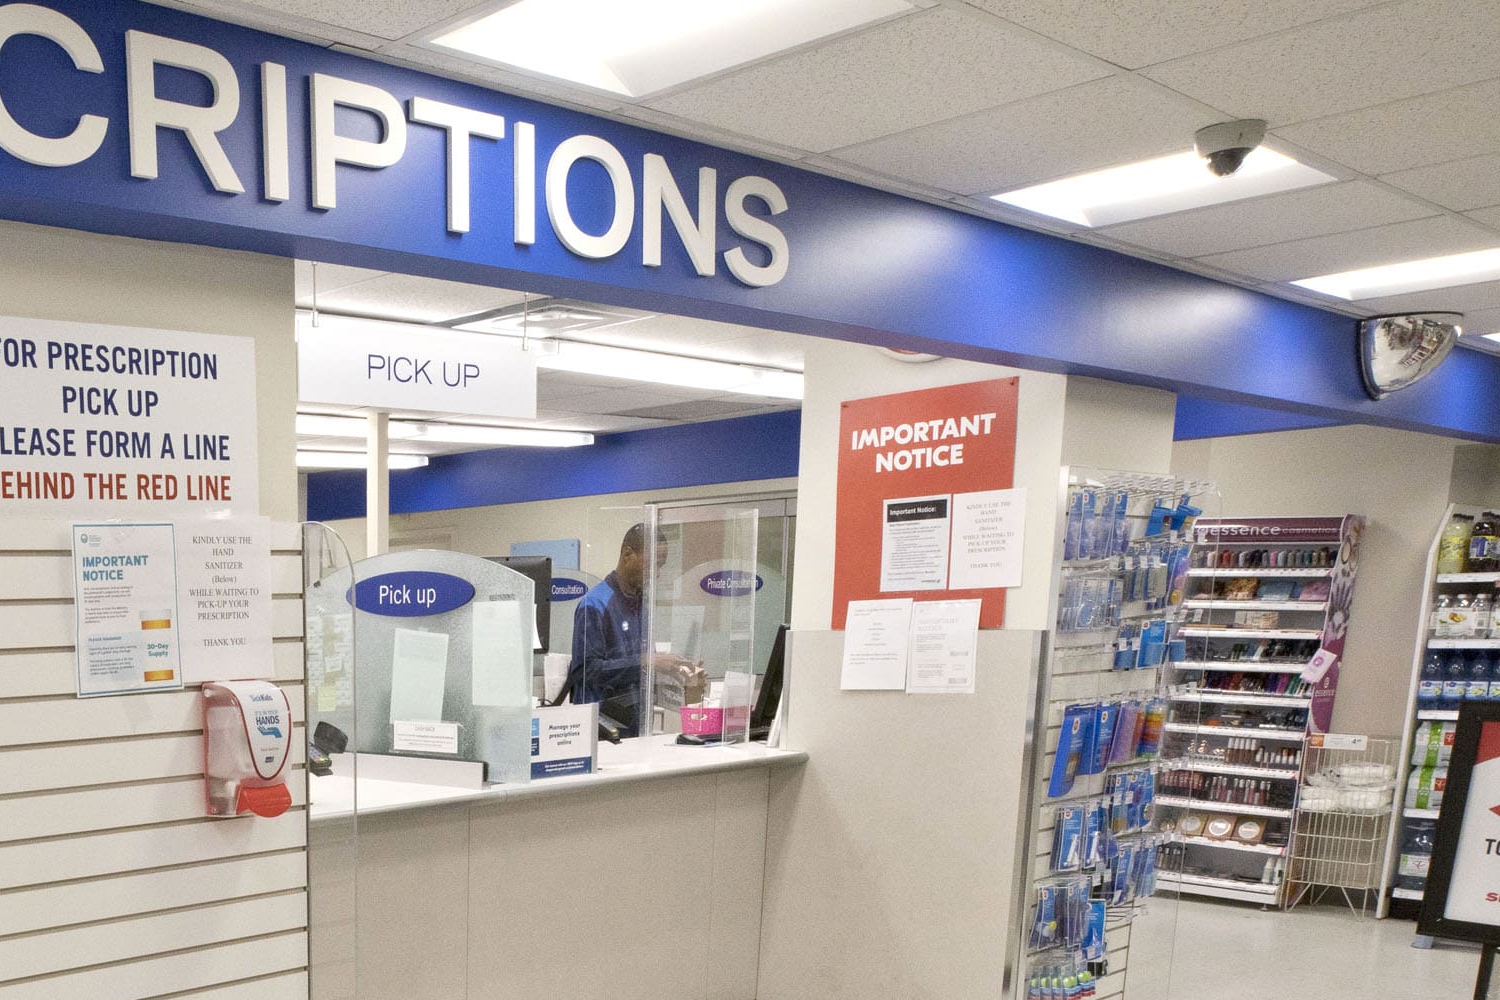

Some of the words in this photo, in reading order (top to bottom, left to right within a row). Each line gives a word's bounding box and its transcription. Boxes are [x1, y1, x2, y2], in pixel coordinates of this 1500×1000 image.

[47, 341, 218, 380] PRESCRIPTION
[368, 354, 432, 385] PICK
[443, 361, 480, 388] UP
[62, 386, 119, 416] PICK
[128, 390, 159, 417] UP
[852, 413, 996, 450] IMPORTANT
[86, 430, 151, 459] FORM
[160, 433, 175, 459] A
[184, 433, 230, 461] LINE
[875, 444, 964, 473] NOTICE
[84, 473, 127, 500] THE
[137, 474, 178, 500] RED
[187, 475, 232, 501] LINE
[889, 507, 916, 517] Important
[917, 506, 937, 514] Notice:
[1210, 525, 1281, 536] essence
[192, 536, 221, 545] KINDLY
[222, 536, 237, 544] USE
[239, 536, 252, 544] THE
[212, 548, 234, 556] HAND
[82, 555, 148, 568] IMPORTANT
[83, 570, 124, 581] NOTICE
[212, 575, 237, 583] (Below)
[189, 589, 213, 597] WHILE
[215, 588, 247, 596] WAITING
[379, 584, 411, 605] Pick
[417, 588, 437, 609] up
[197, 600, 227, 608] PICK-UP
[197, 611, 250, 620] PRESCRIPTION
[255, 716, 280, 725] HANDS
